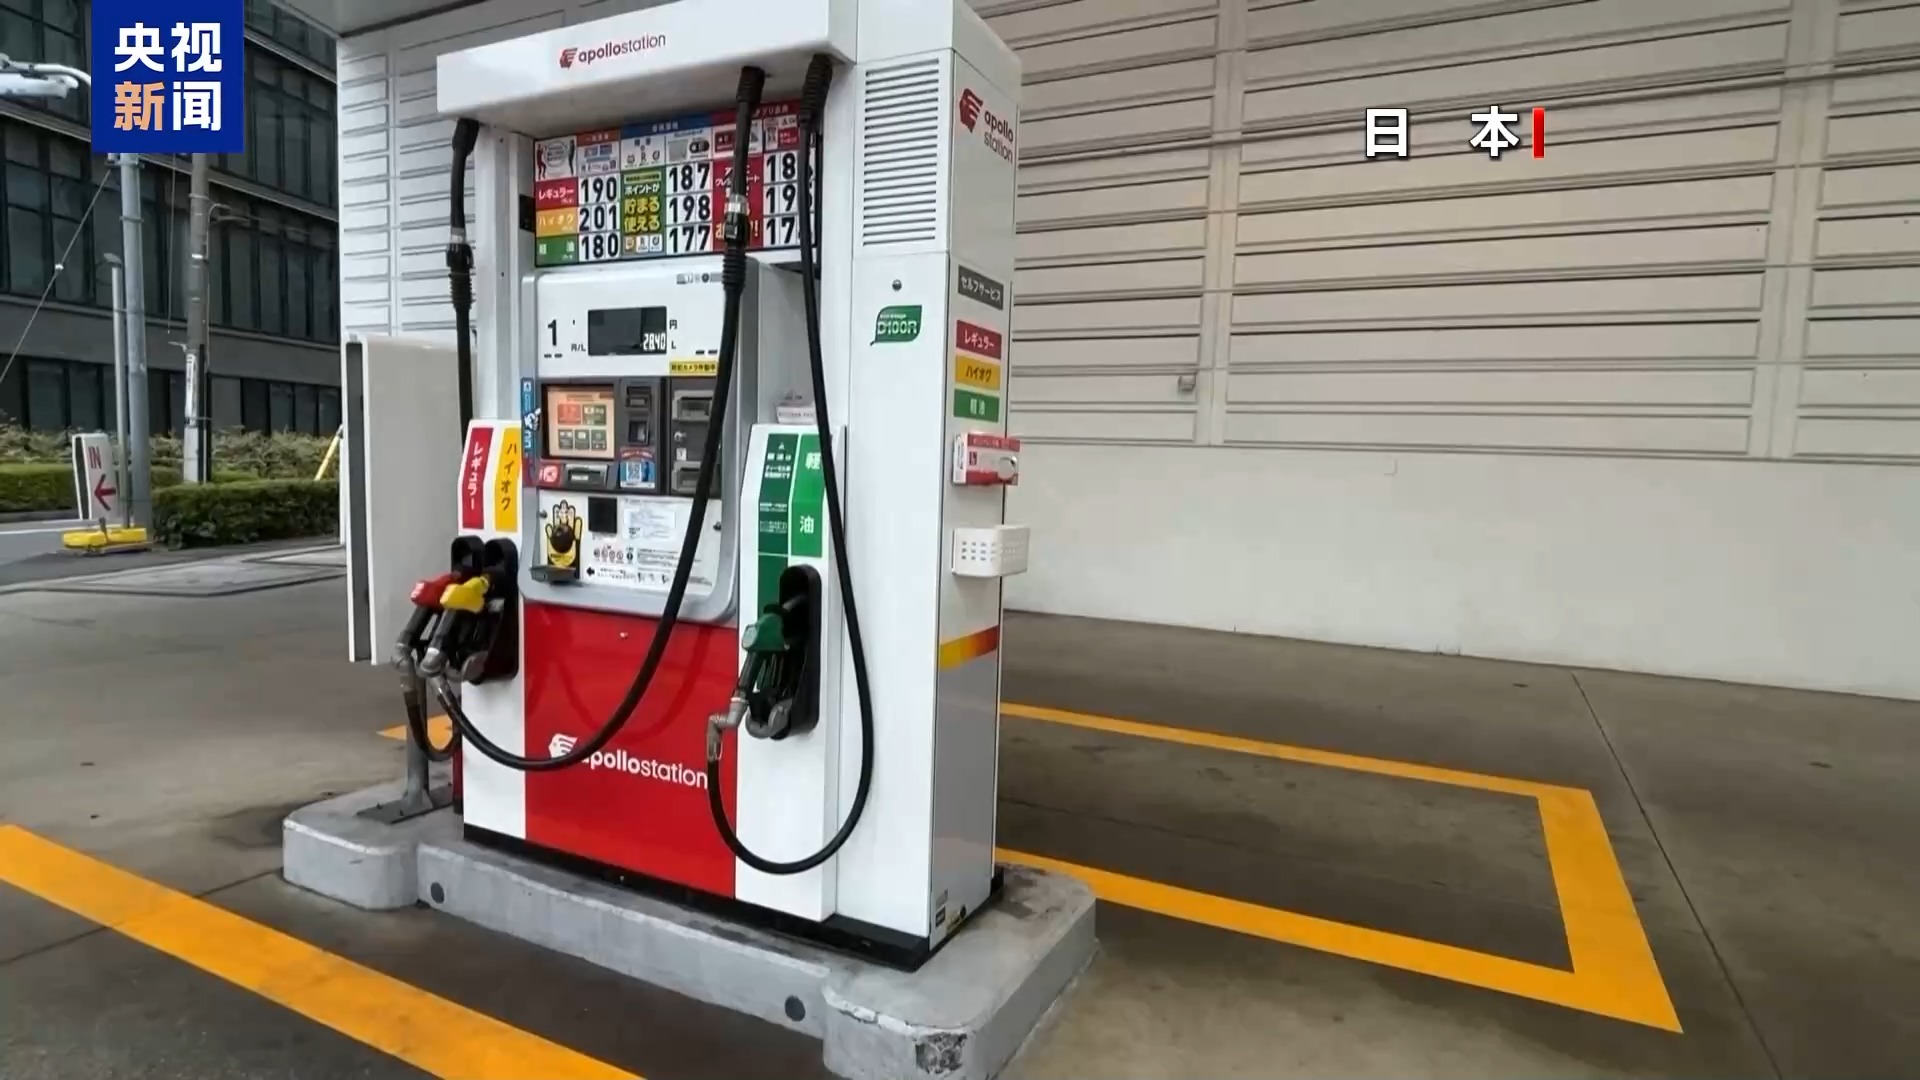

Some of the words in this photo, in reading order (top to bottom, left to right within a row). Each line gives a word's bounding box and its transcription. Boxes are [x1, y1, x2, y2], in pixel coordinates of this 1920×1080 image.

[578, 34, 666, 65] apollostation
[984, 110, 1014, 142] apollo
[983, 131, 1013, 164] station
[580, 176, 618, 204] 190
[625, 182, 660, 195] ポイントが
[669, 163, 711, 193] 187
[538, 187, 575, 201] レギュラー
[624, 196, 660, 215] 貯まる
[538, 214, 575, 227] ハイオク
[579, 204, 617, 232] 201
[669, 194, 711, 224] 198
[624, 215, 660, 233] 使える
[581, 232, 619, 261] 180
[669, 225, 711, 254] 177
[961, 276, 1001, 303] セルフサービス
[547, 319, 557, 346] 1
[964, 329, 995, 350] レギュラー
[965, 365, 992, 383] ハイオク
[88, 446, 102, 470] IN
[467, 441, 484, 511] レギュラー
[500, 443, 517, 512] ハイオク
